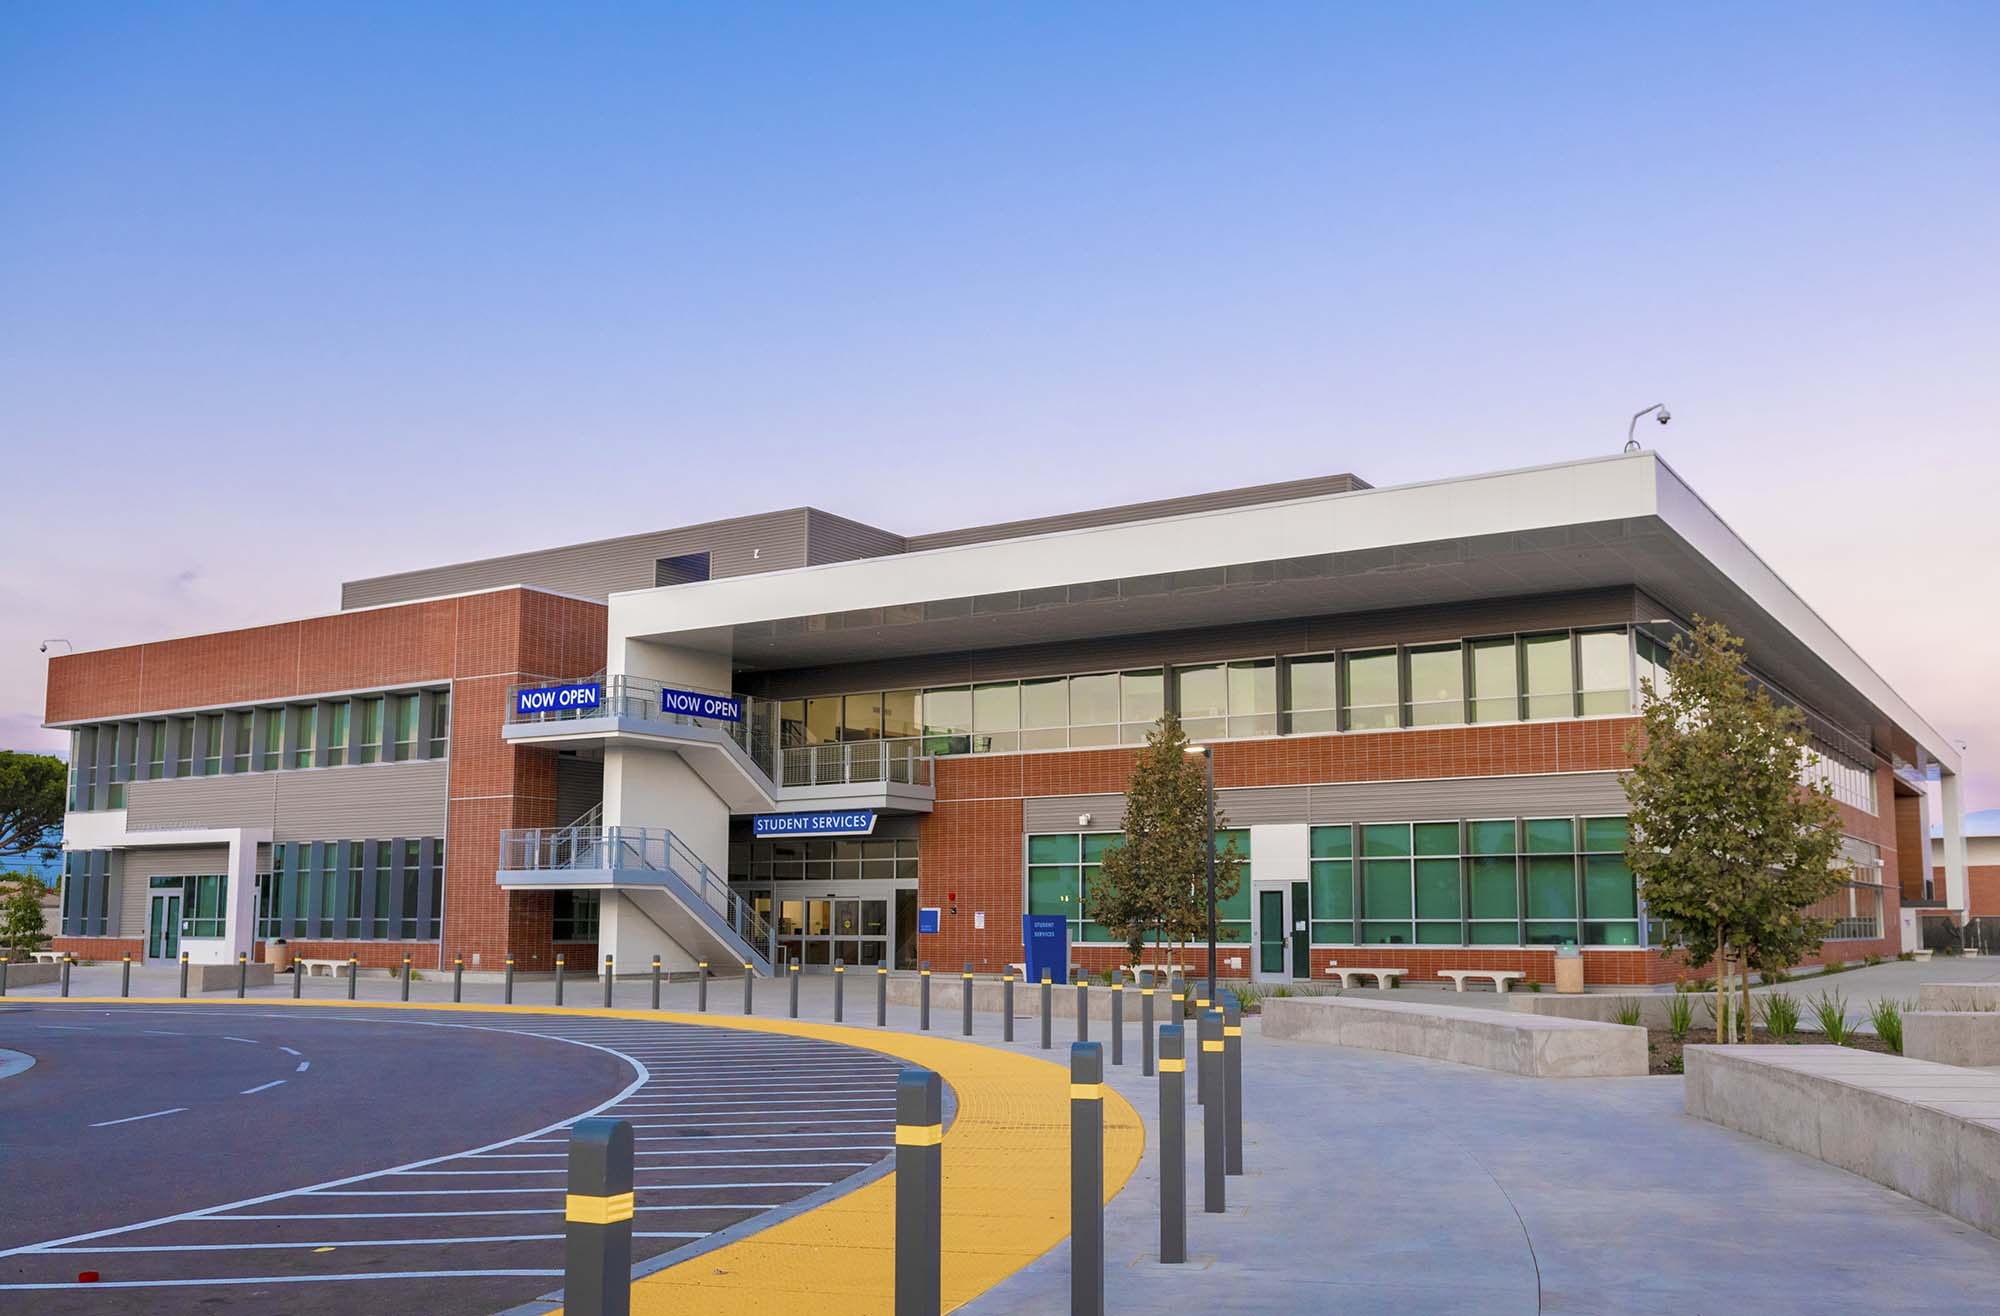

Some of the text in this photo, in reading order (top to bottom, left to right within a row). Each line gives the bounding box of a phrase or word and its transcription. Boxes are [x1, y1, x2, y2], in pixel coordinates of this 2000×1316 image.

[521, 688, 596, 709] NOW OPEN
[667, 693, 738, 718] NOW OPEN
[757, 815, 867, 831] STUDENT SERVICES
